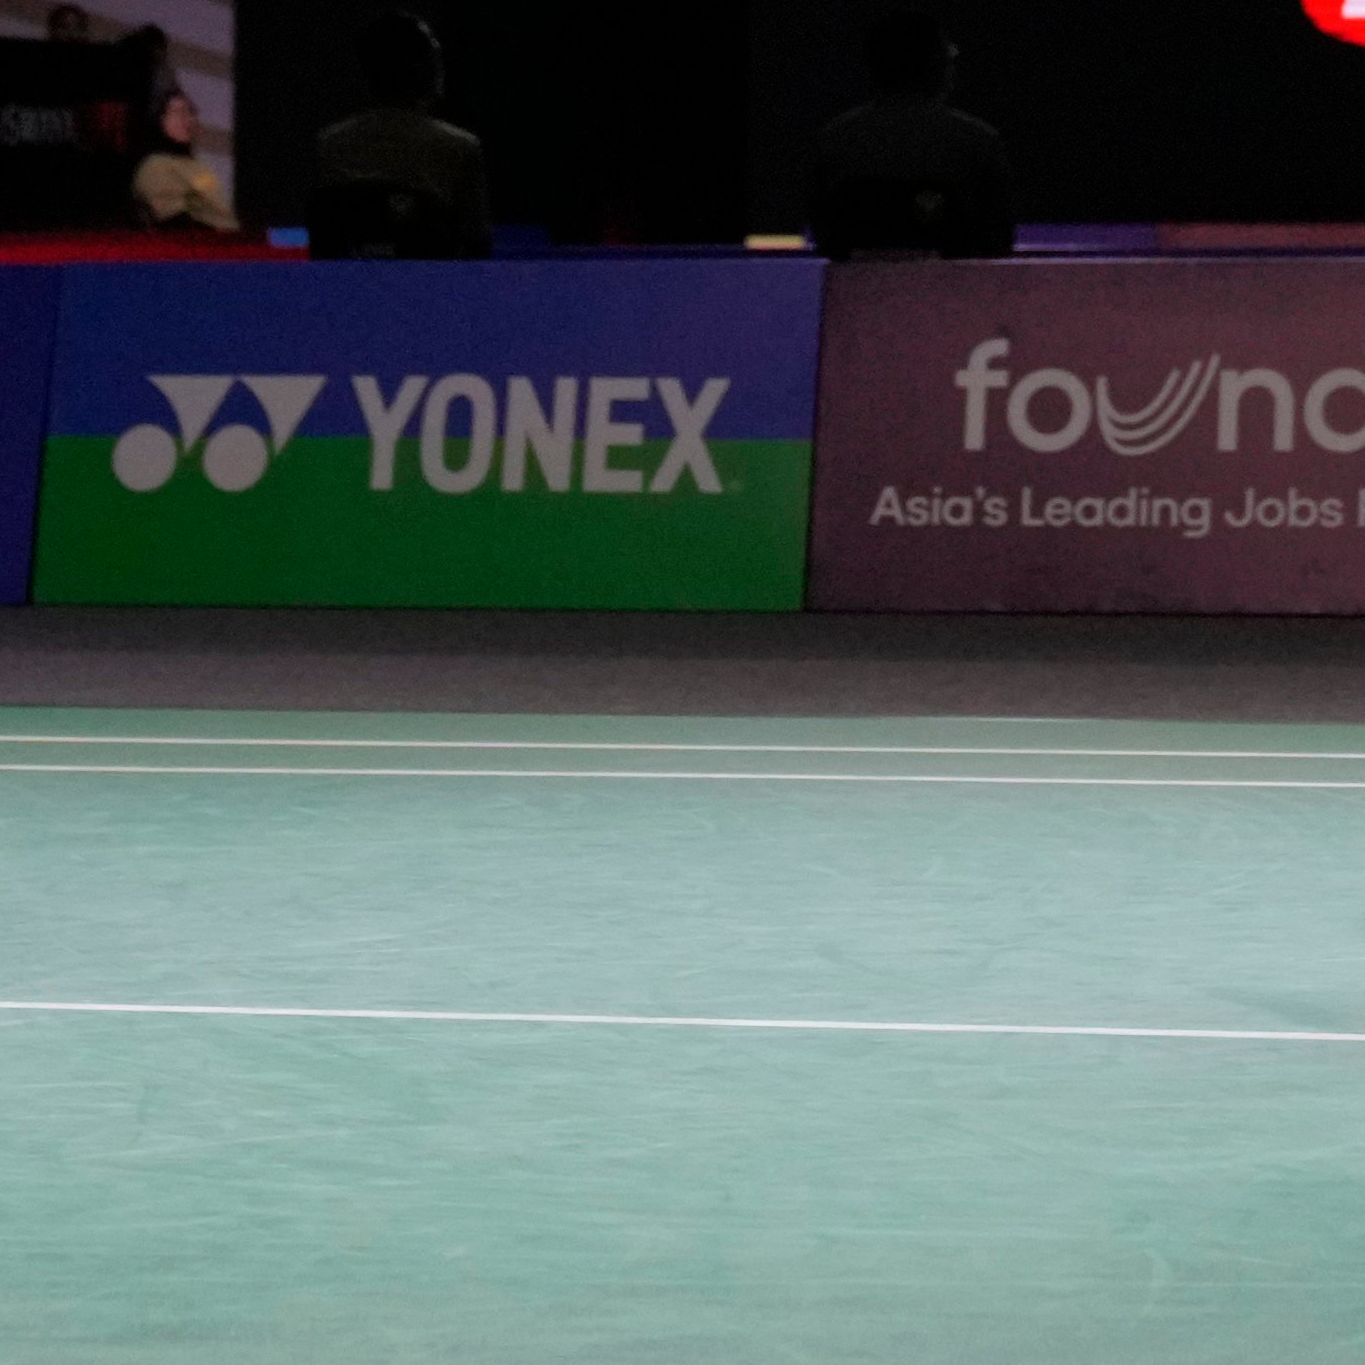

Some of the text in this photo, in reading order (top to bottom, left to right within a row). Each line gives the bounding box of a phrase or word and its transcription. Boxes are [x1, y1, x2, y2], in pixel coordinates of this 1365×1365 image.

[351, 373, 731, 493] YONEX
[869, 486, 1008, 528] Asia's
[1021, 487, 1212, 539] Leading
[1224, 487, 1344, 528] Jobs
